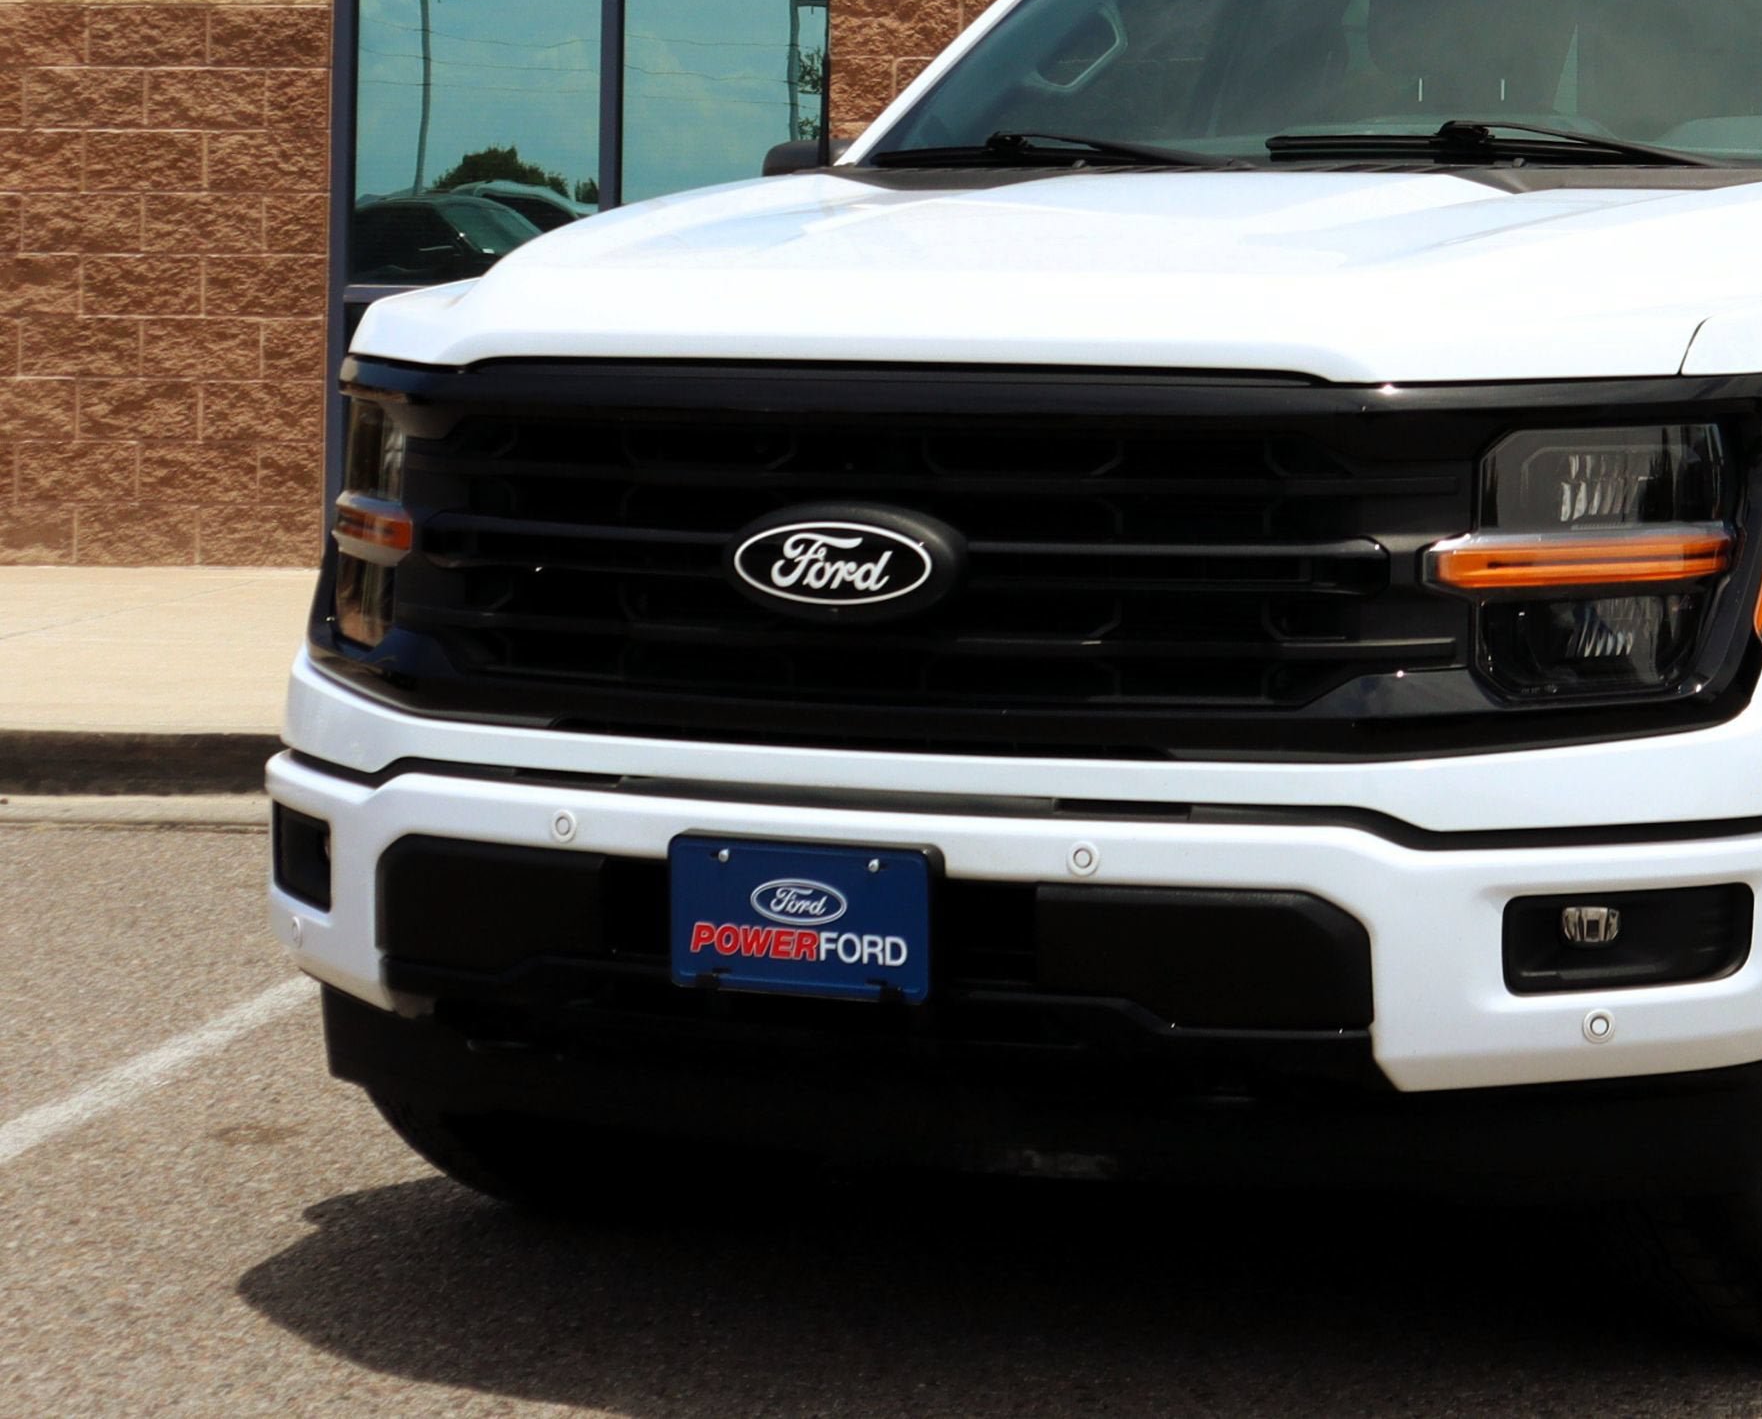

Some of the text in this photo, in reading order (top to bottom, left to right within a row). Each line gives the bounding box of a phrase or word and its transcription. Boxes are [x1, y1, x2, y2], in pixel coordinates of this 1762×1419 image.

[771, 532, 893, 591] Ford
[770, 883, 828, 919] Ford
[690, 921, 909, 968] POWERFORD
